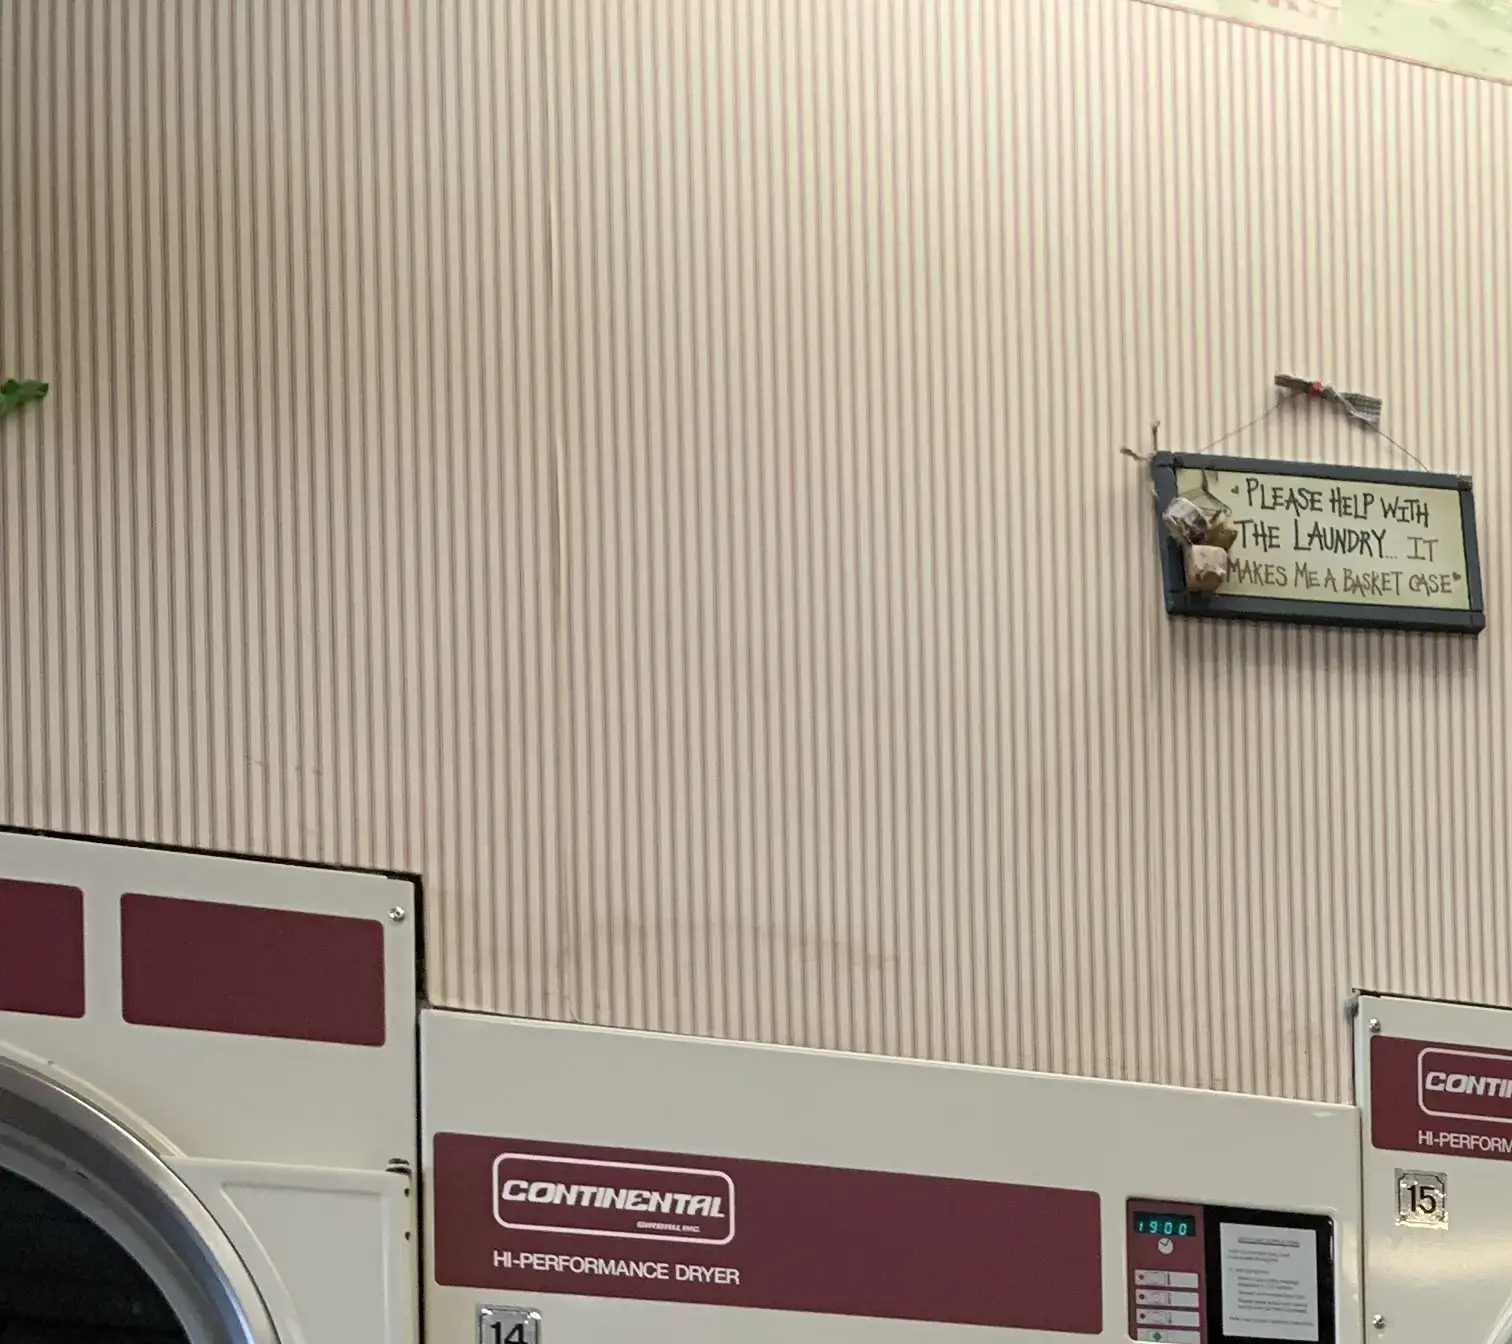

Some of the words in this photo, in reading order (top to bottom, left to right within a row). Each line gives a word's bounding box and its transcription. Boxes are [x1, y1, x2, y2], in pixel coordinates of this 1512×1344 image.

[1245, 477, 1323, 518] PLEASE
[1328, 489, 1375, 520] HELP
[1380, 497, 1430, 528] WITH
[1234, 519, 1281, 550] THE
[1406, 536, 1439, 561] IT
[1226, 558, 1288, 587] MAKES
[1294, 562, 1320, 588] ME
[1324, 568, 1337, 593] A
[1342, 568, 1403, 597] BASKET
[501, 1179, 726, 1218] CONTINENTAL
[1406, 1184, 1437, 1214] 15
[493, 1250, 670, 1281] HI-PERFORMANCE
[675, 1264, 741, 1285] DRYER
